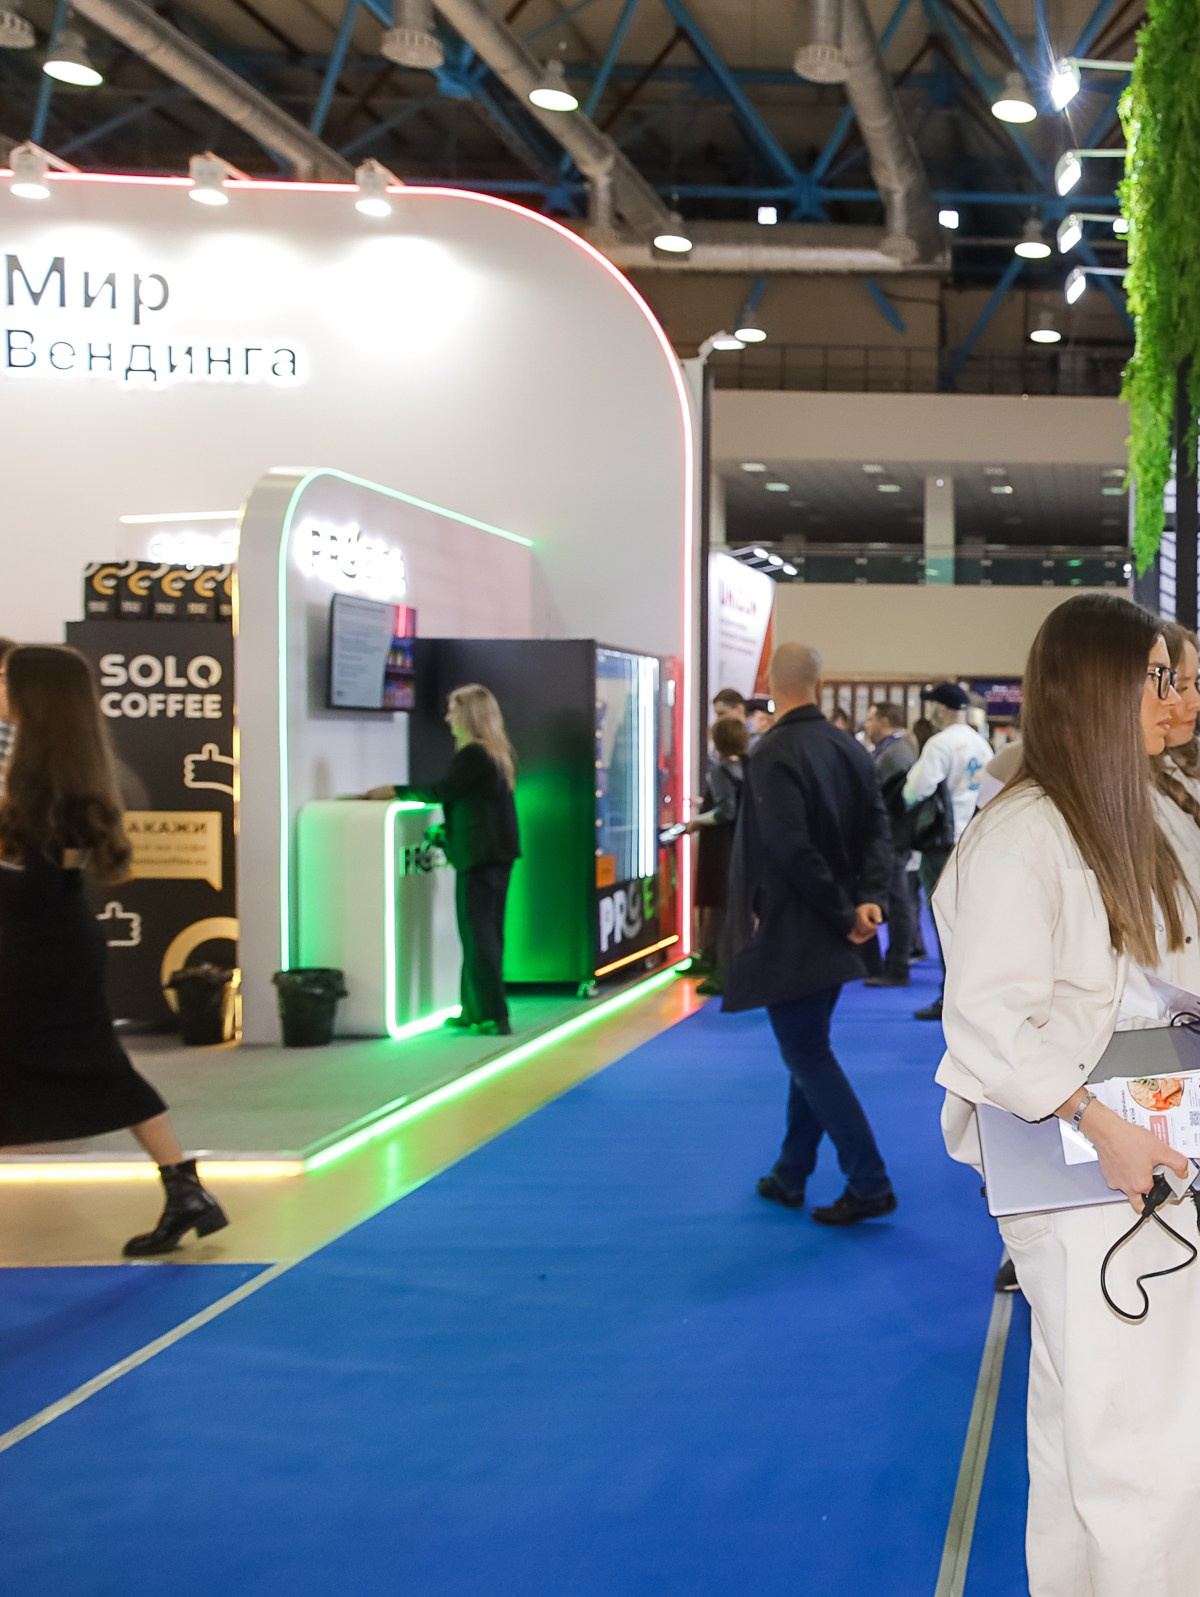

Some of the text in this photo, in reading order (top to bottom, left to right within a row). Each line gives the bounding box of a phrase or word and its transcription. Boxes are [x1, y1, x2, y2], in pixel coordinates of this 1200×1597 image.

[6, 254, 169, 325] Мир
[6, 328, 296, 382] Вендинга
[100, 653, 222, 688] SOLO
[100, 692, 222, 719] COFFEE
[127, 822, 207, 833] АКАЖИ
